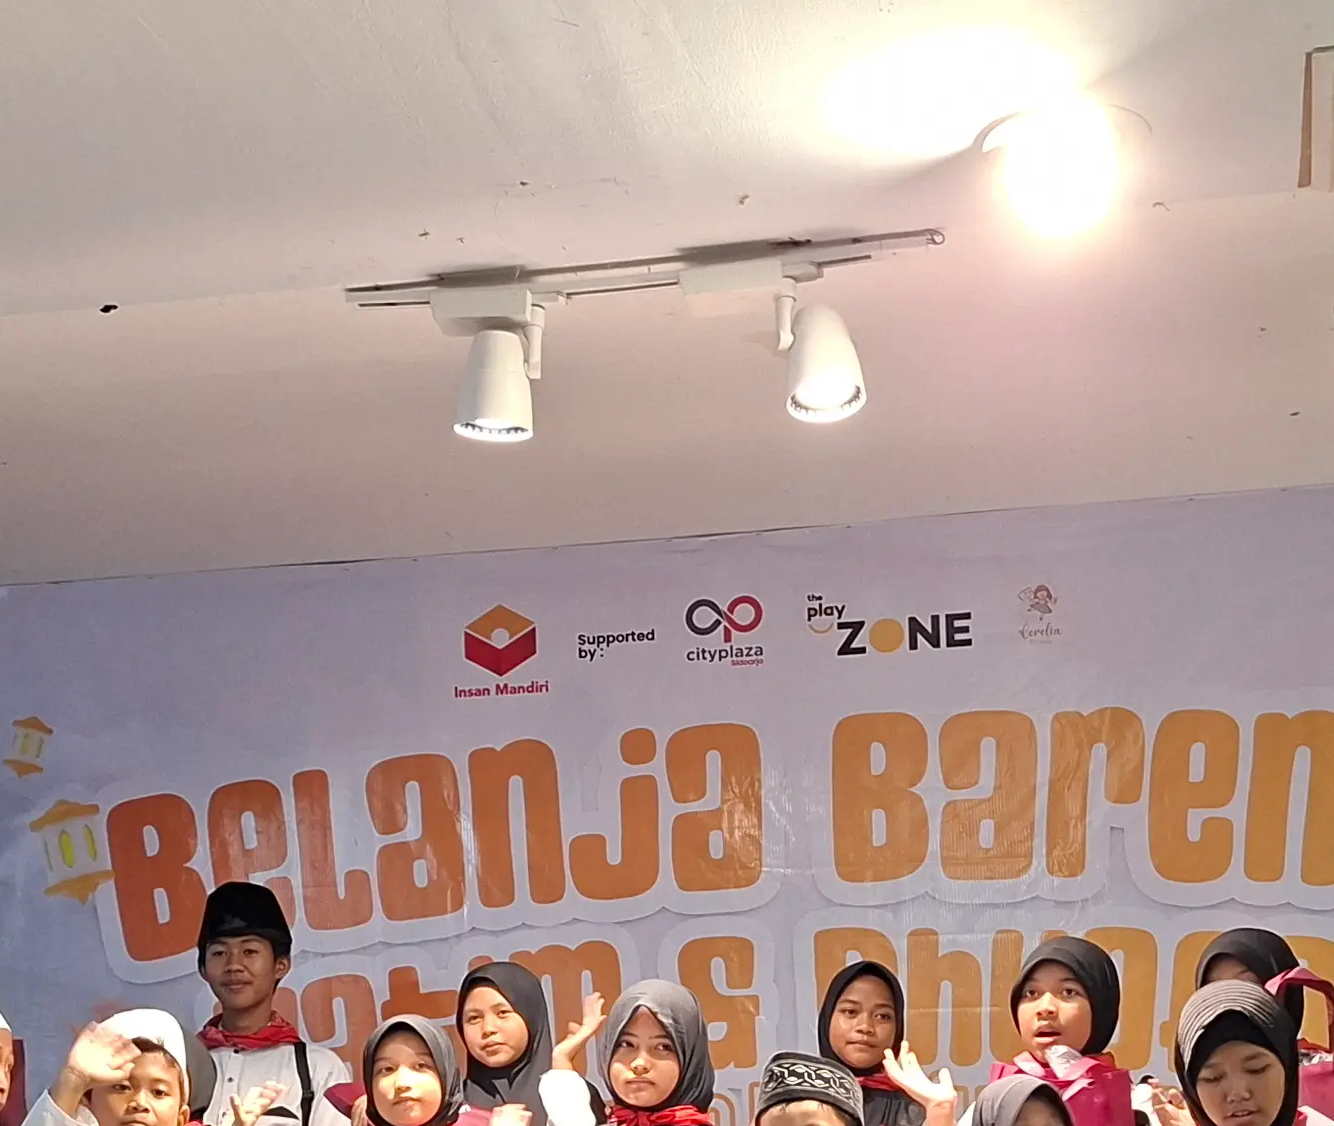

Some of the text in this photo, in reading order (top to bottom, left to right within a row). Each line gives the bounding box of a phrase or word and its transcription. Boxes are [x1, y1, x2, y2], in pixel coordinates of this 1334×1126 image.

[807, 593, 823, 602] the
[807, 603, 845, 622] play
[577, 629, 656, 648] Supported
[836, 611, 973, 657] ZONE
[686, 644, 764, 662] cityplaza
[454, 680, 550, 698] Insan Mandiri
[106, 722, 764, 963] Belanja
